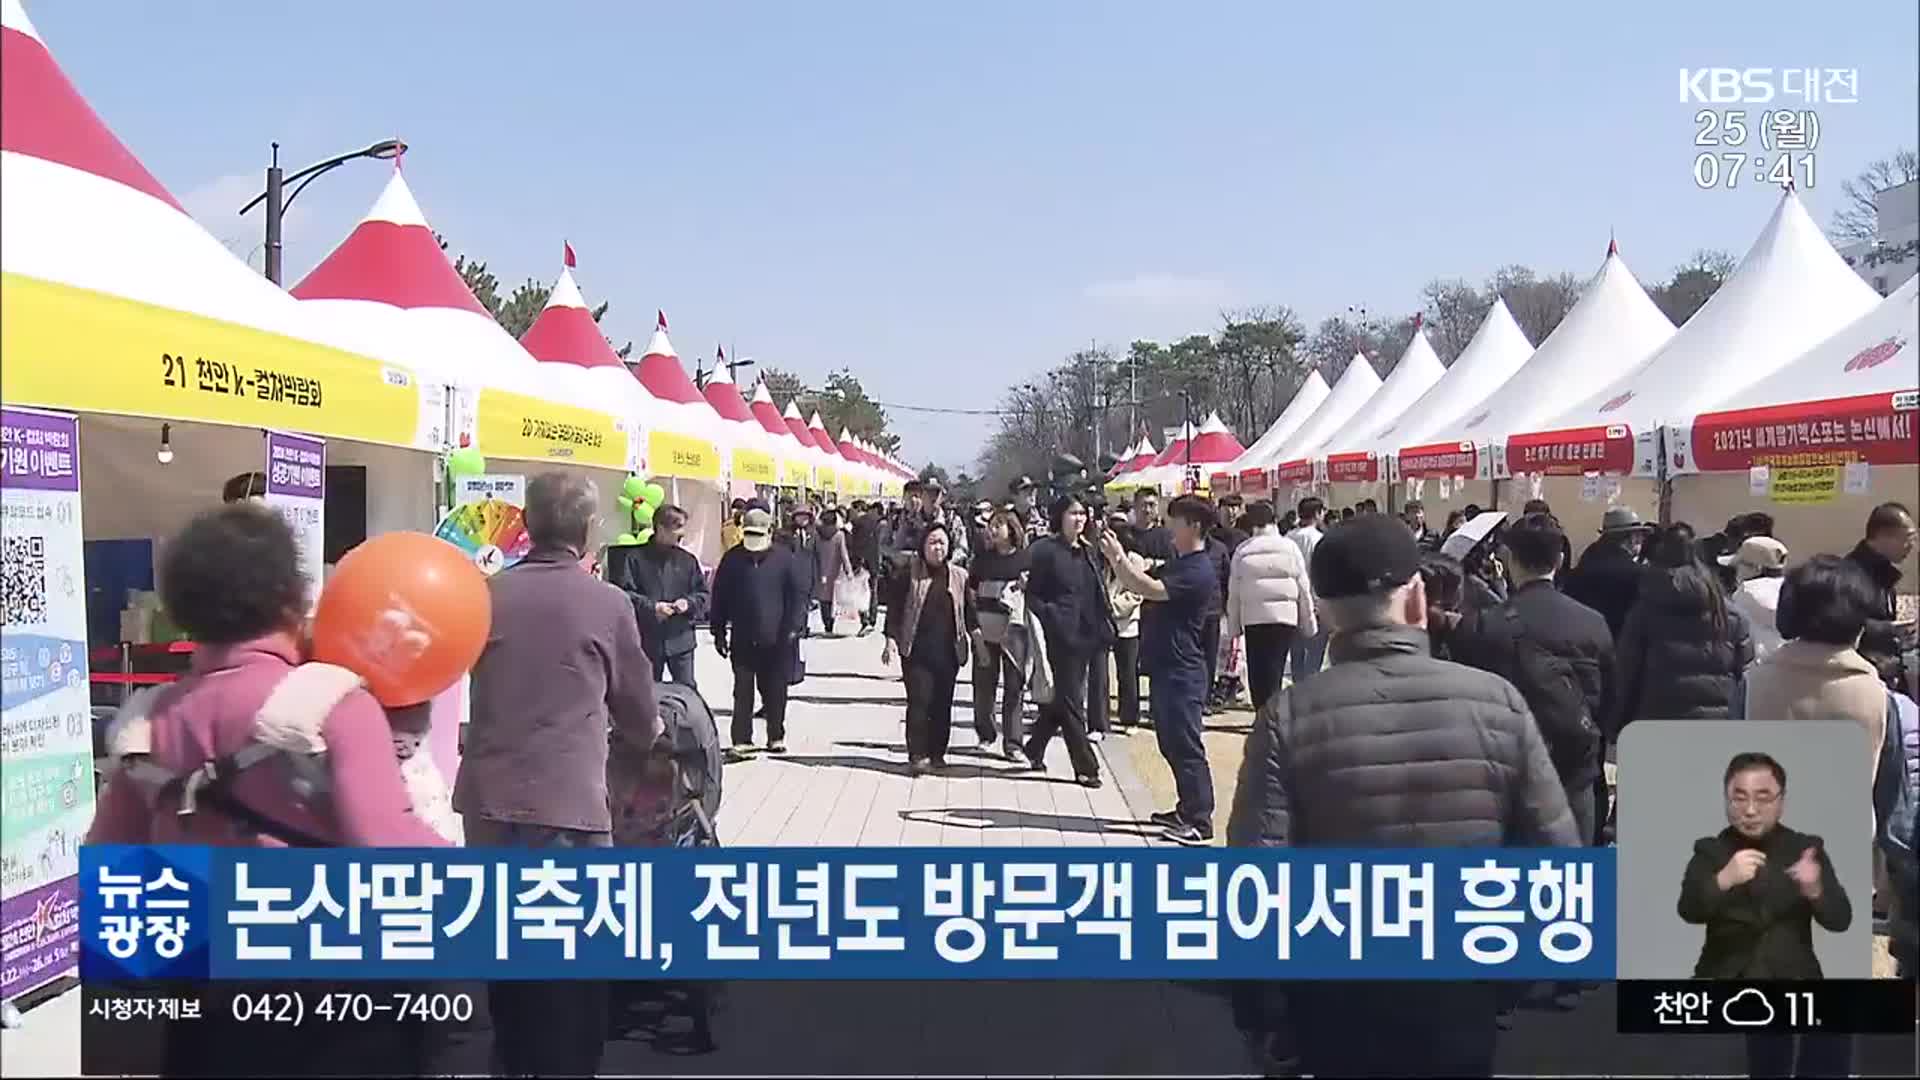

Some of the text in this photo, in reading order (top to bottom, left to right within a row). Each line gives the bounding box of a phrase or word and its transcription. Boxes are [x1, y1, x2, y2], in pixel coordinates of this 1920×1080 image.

[161, 353, 187, 388] 21
[196, 357, 229, 393] 천안
[30, 449, 73, 477] 이벤트
